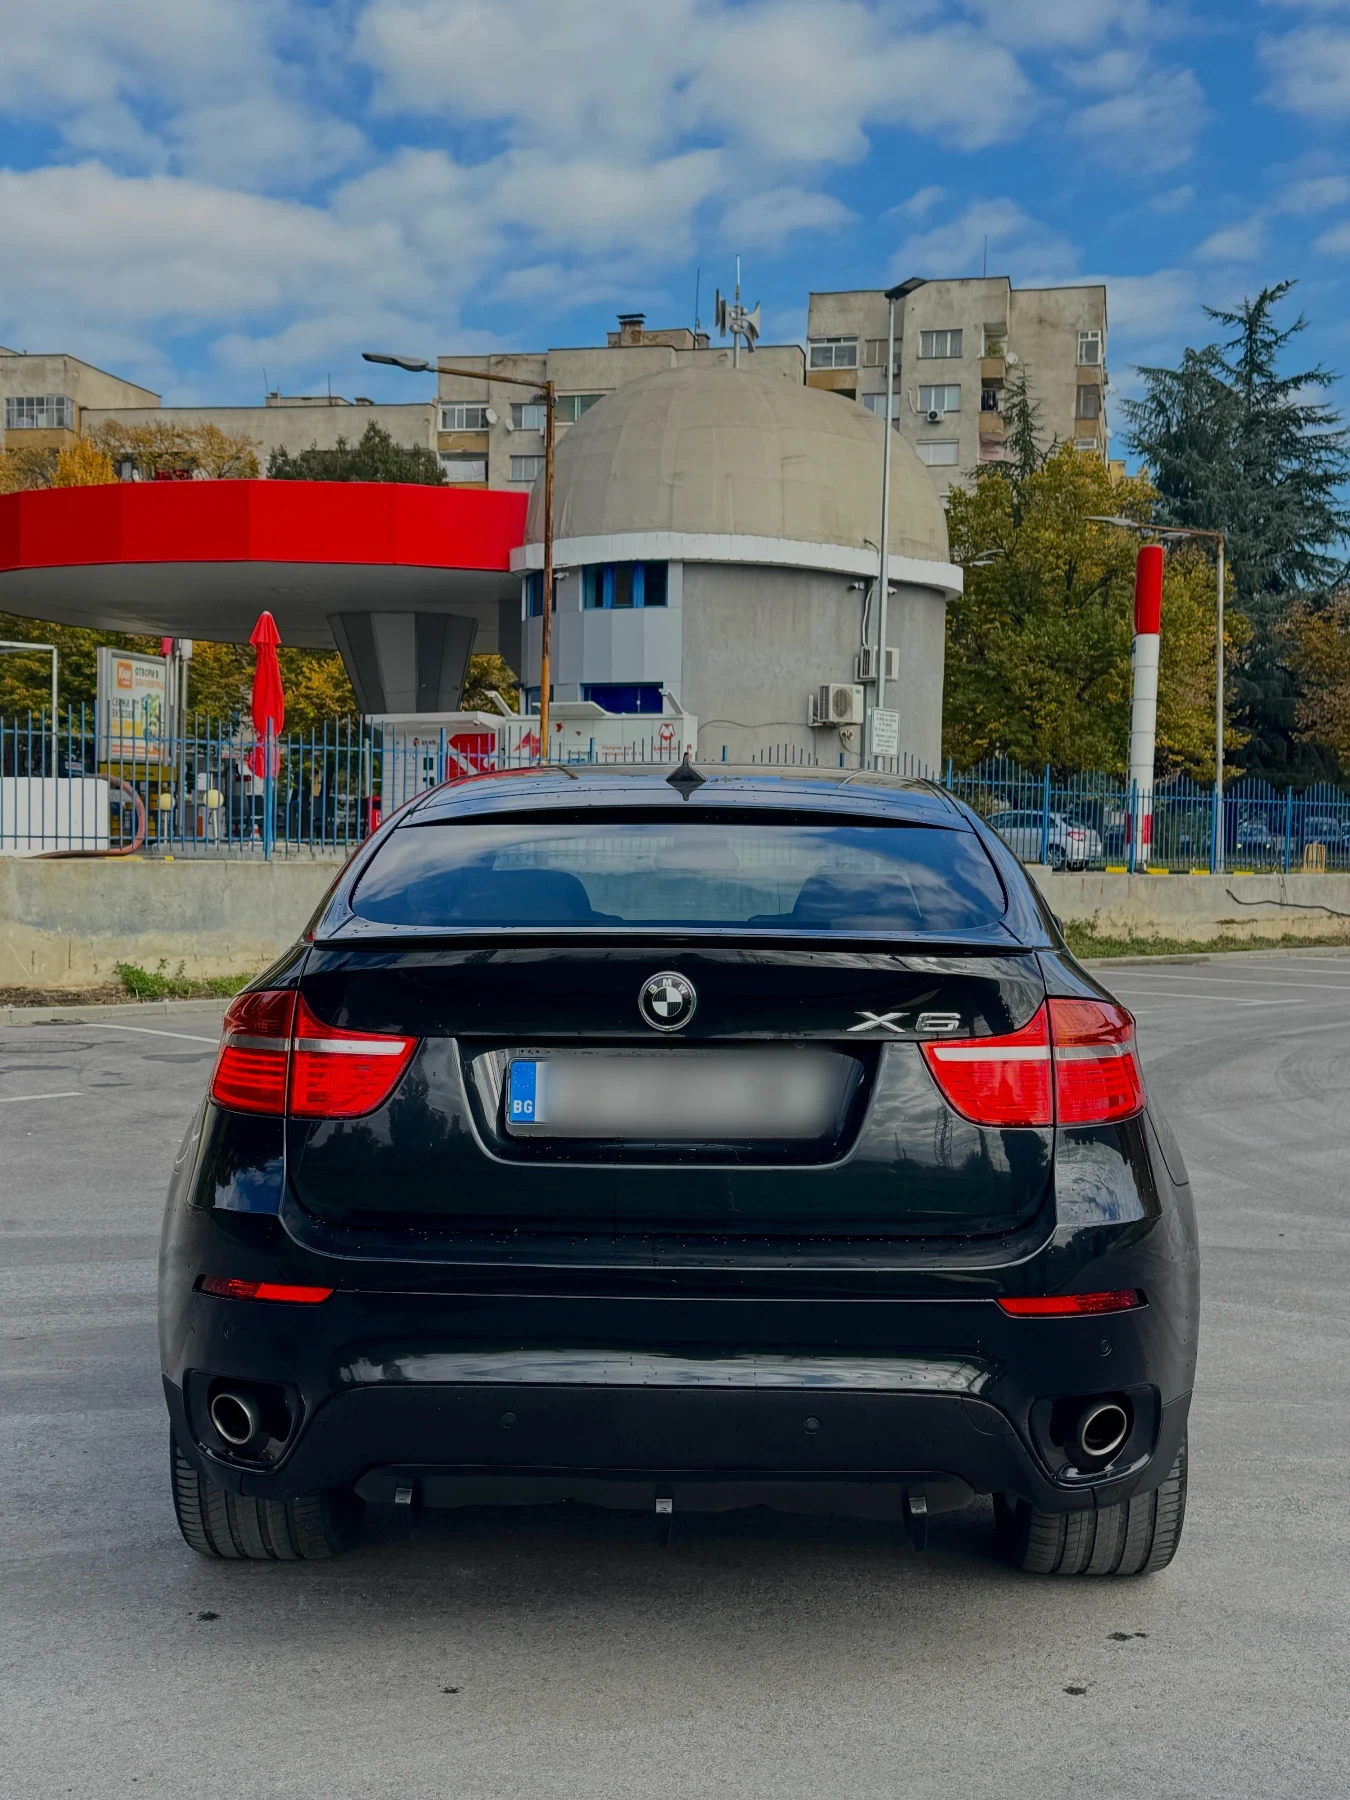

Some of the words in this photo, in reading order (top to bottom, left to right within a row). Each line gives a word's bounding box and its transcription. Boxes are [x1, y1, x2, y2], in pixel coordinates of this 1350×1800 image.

[135, 668, 154, 678] ОТВОРИ
[647, 978, 689, 995] BMW
[846, 1011, 961, 1033] X6
[513, 1099, 533, 1114] BG
